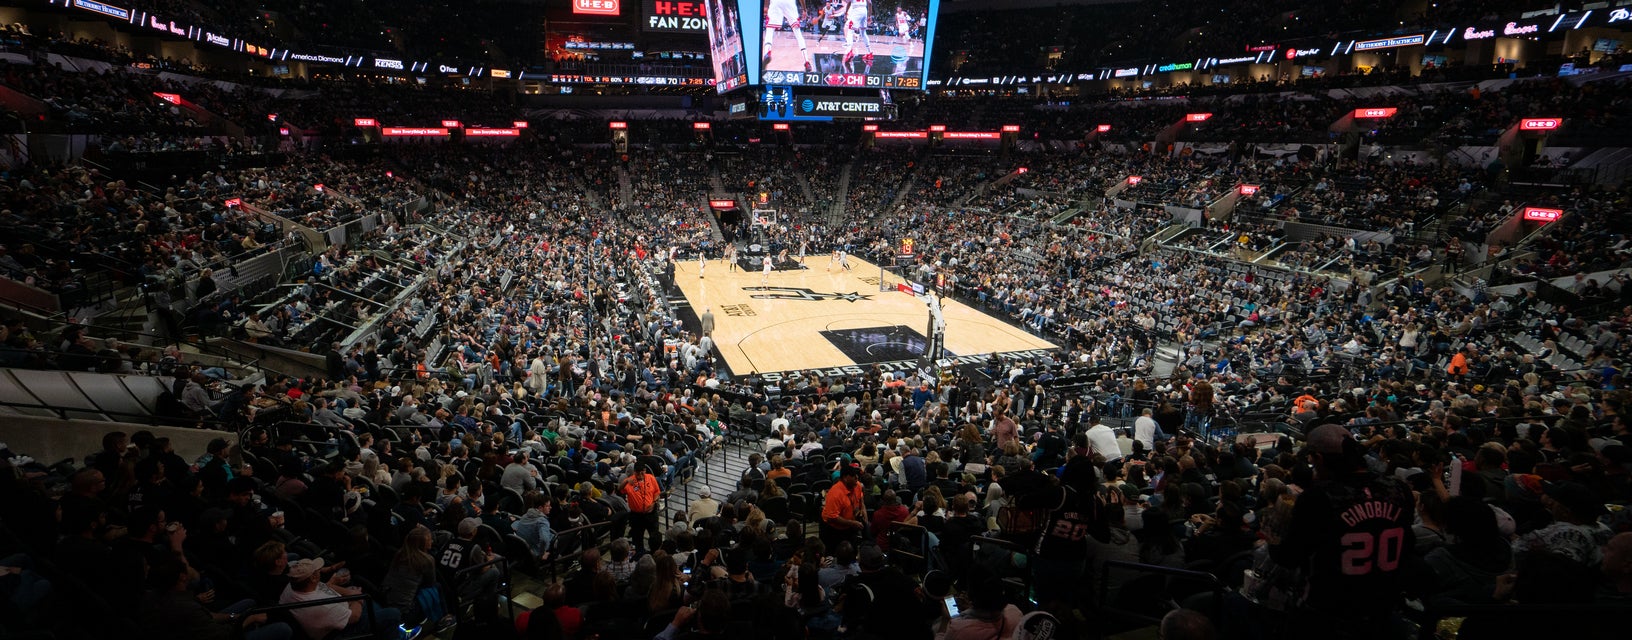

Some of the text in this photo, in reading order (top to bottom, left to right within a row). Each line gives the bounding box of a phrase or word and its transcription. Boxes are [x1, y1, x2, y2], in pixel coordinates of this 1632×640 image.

[650, 16, 708, 30] FAN ZON
[786, 72, 800, 82] SA
[806, 74, 818, 83] 70
[847, 76, 863, 85] CHI
[868, 77, 880, 85] 50
[898, 78, 918, 87] 7:25
[816, 102, 879, 112] AT&T CENTER
[1341, 501, 1402, 527] GINOBILI
[1052, 519, 1088, 541] 20
[440, 550, 462, 568] 20
[1340, 527, 1404, 575] 20
